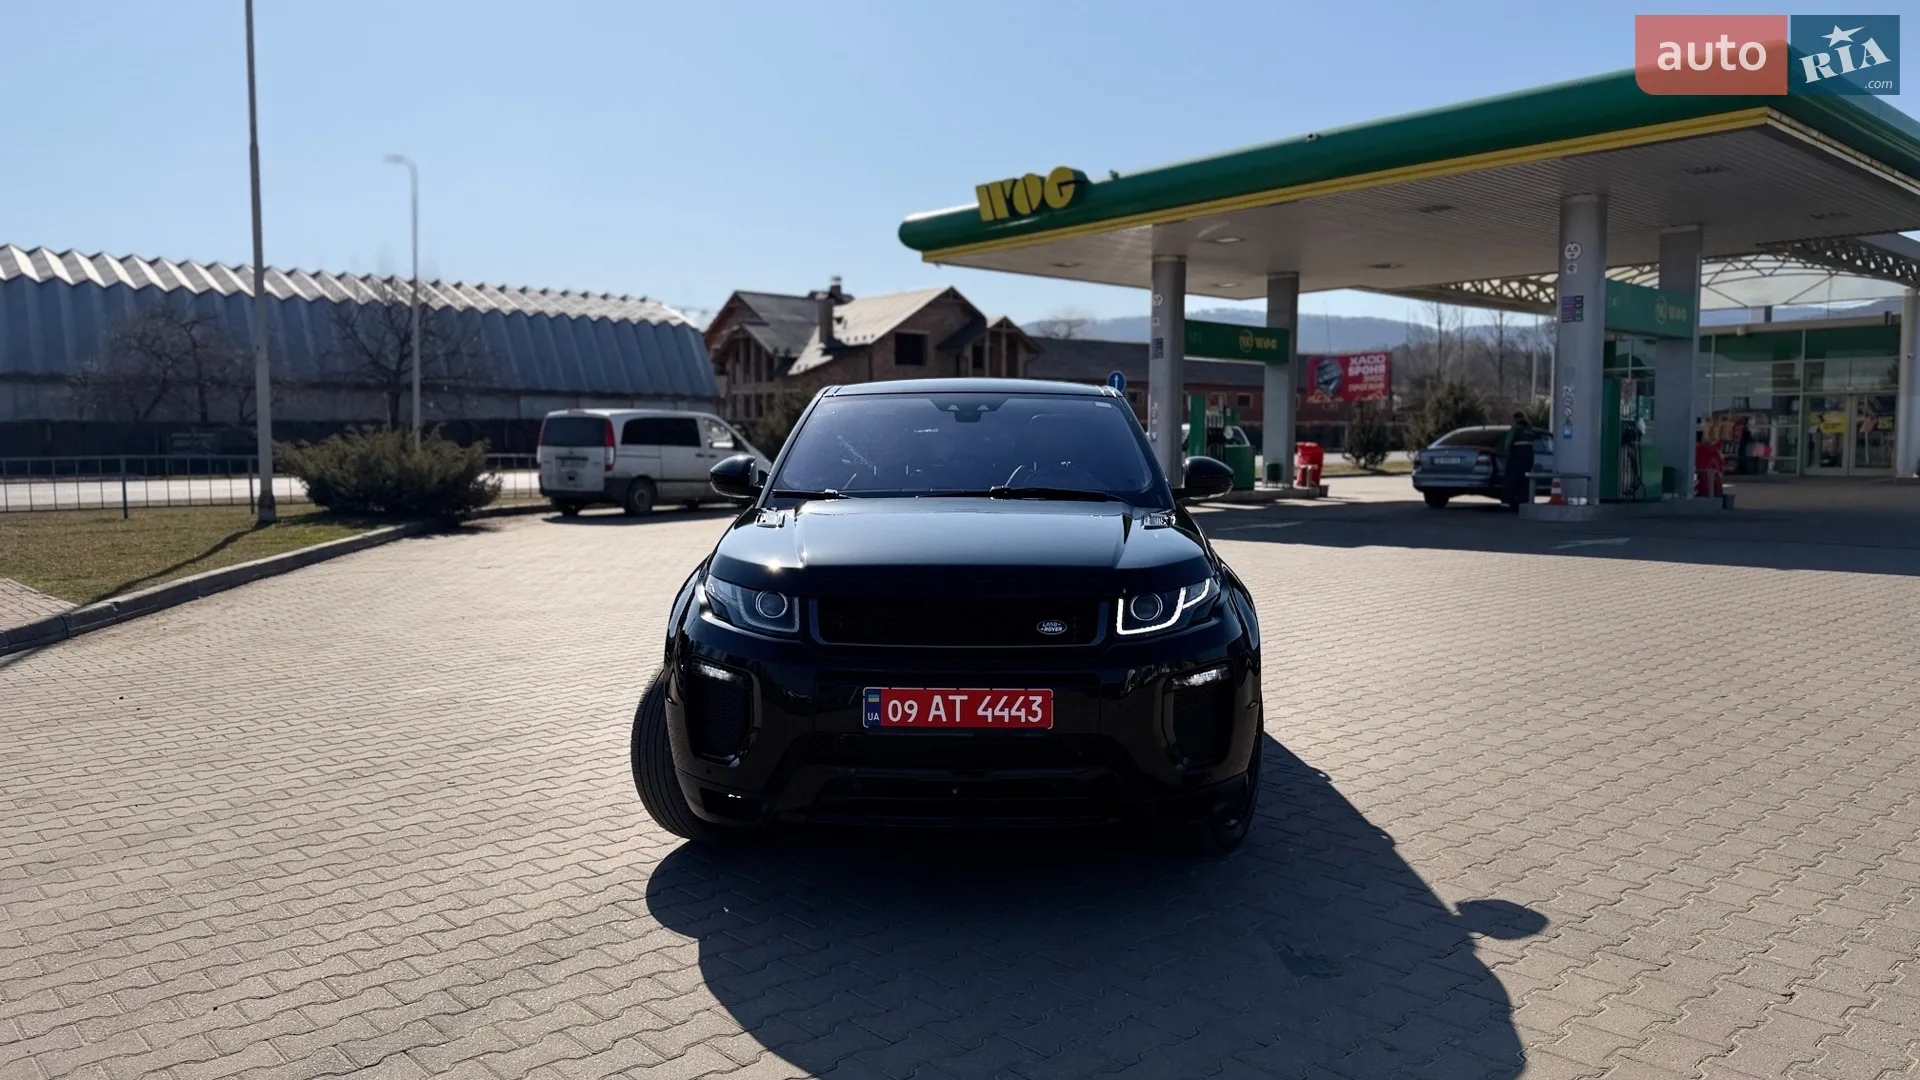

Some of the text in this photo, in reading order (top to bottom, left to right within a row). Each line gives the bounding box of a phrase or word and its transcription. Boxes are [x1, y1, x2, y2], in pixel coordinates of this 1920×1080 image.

[976, 166, 1076, 221] WOG
[867, 712, 880, 721] UA
[887, 695, 1043, 723] 09 AT 4443
